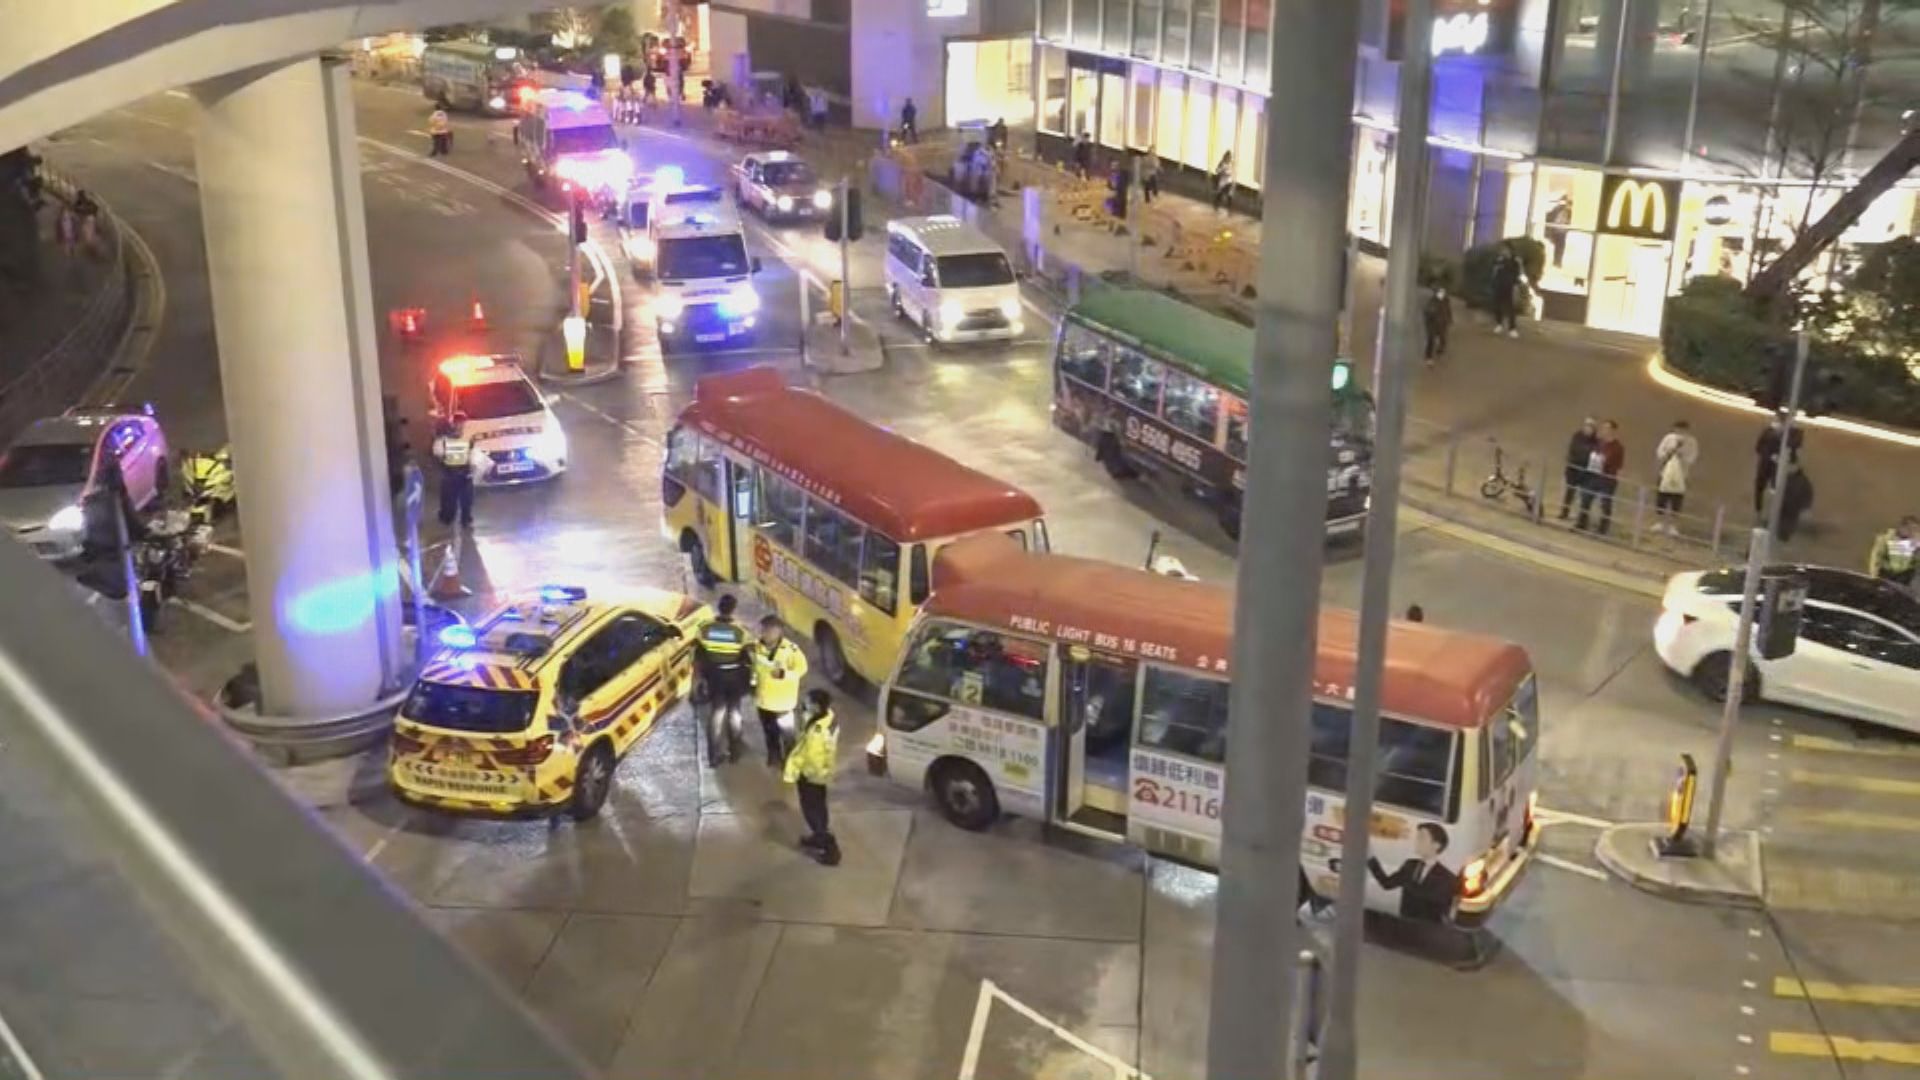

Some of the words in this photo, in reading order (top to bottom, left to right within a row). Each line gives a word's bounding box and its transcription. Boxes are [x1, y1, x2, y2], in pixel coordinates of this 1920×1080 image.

[1010, 615, 1050, 634] PUBLIC
[1057, 624, 1090, 642] LIGHT
[1094, 632, 1119, 649] BUS
[1124, 638, 1136, 651] 16
[1140, 641, 1178, 660] SEATS
[1162, 786, 1219, 819] 2116
